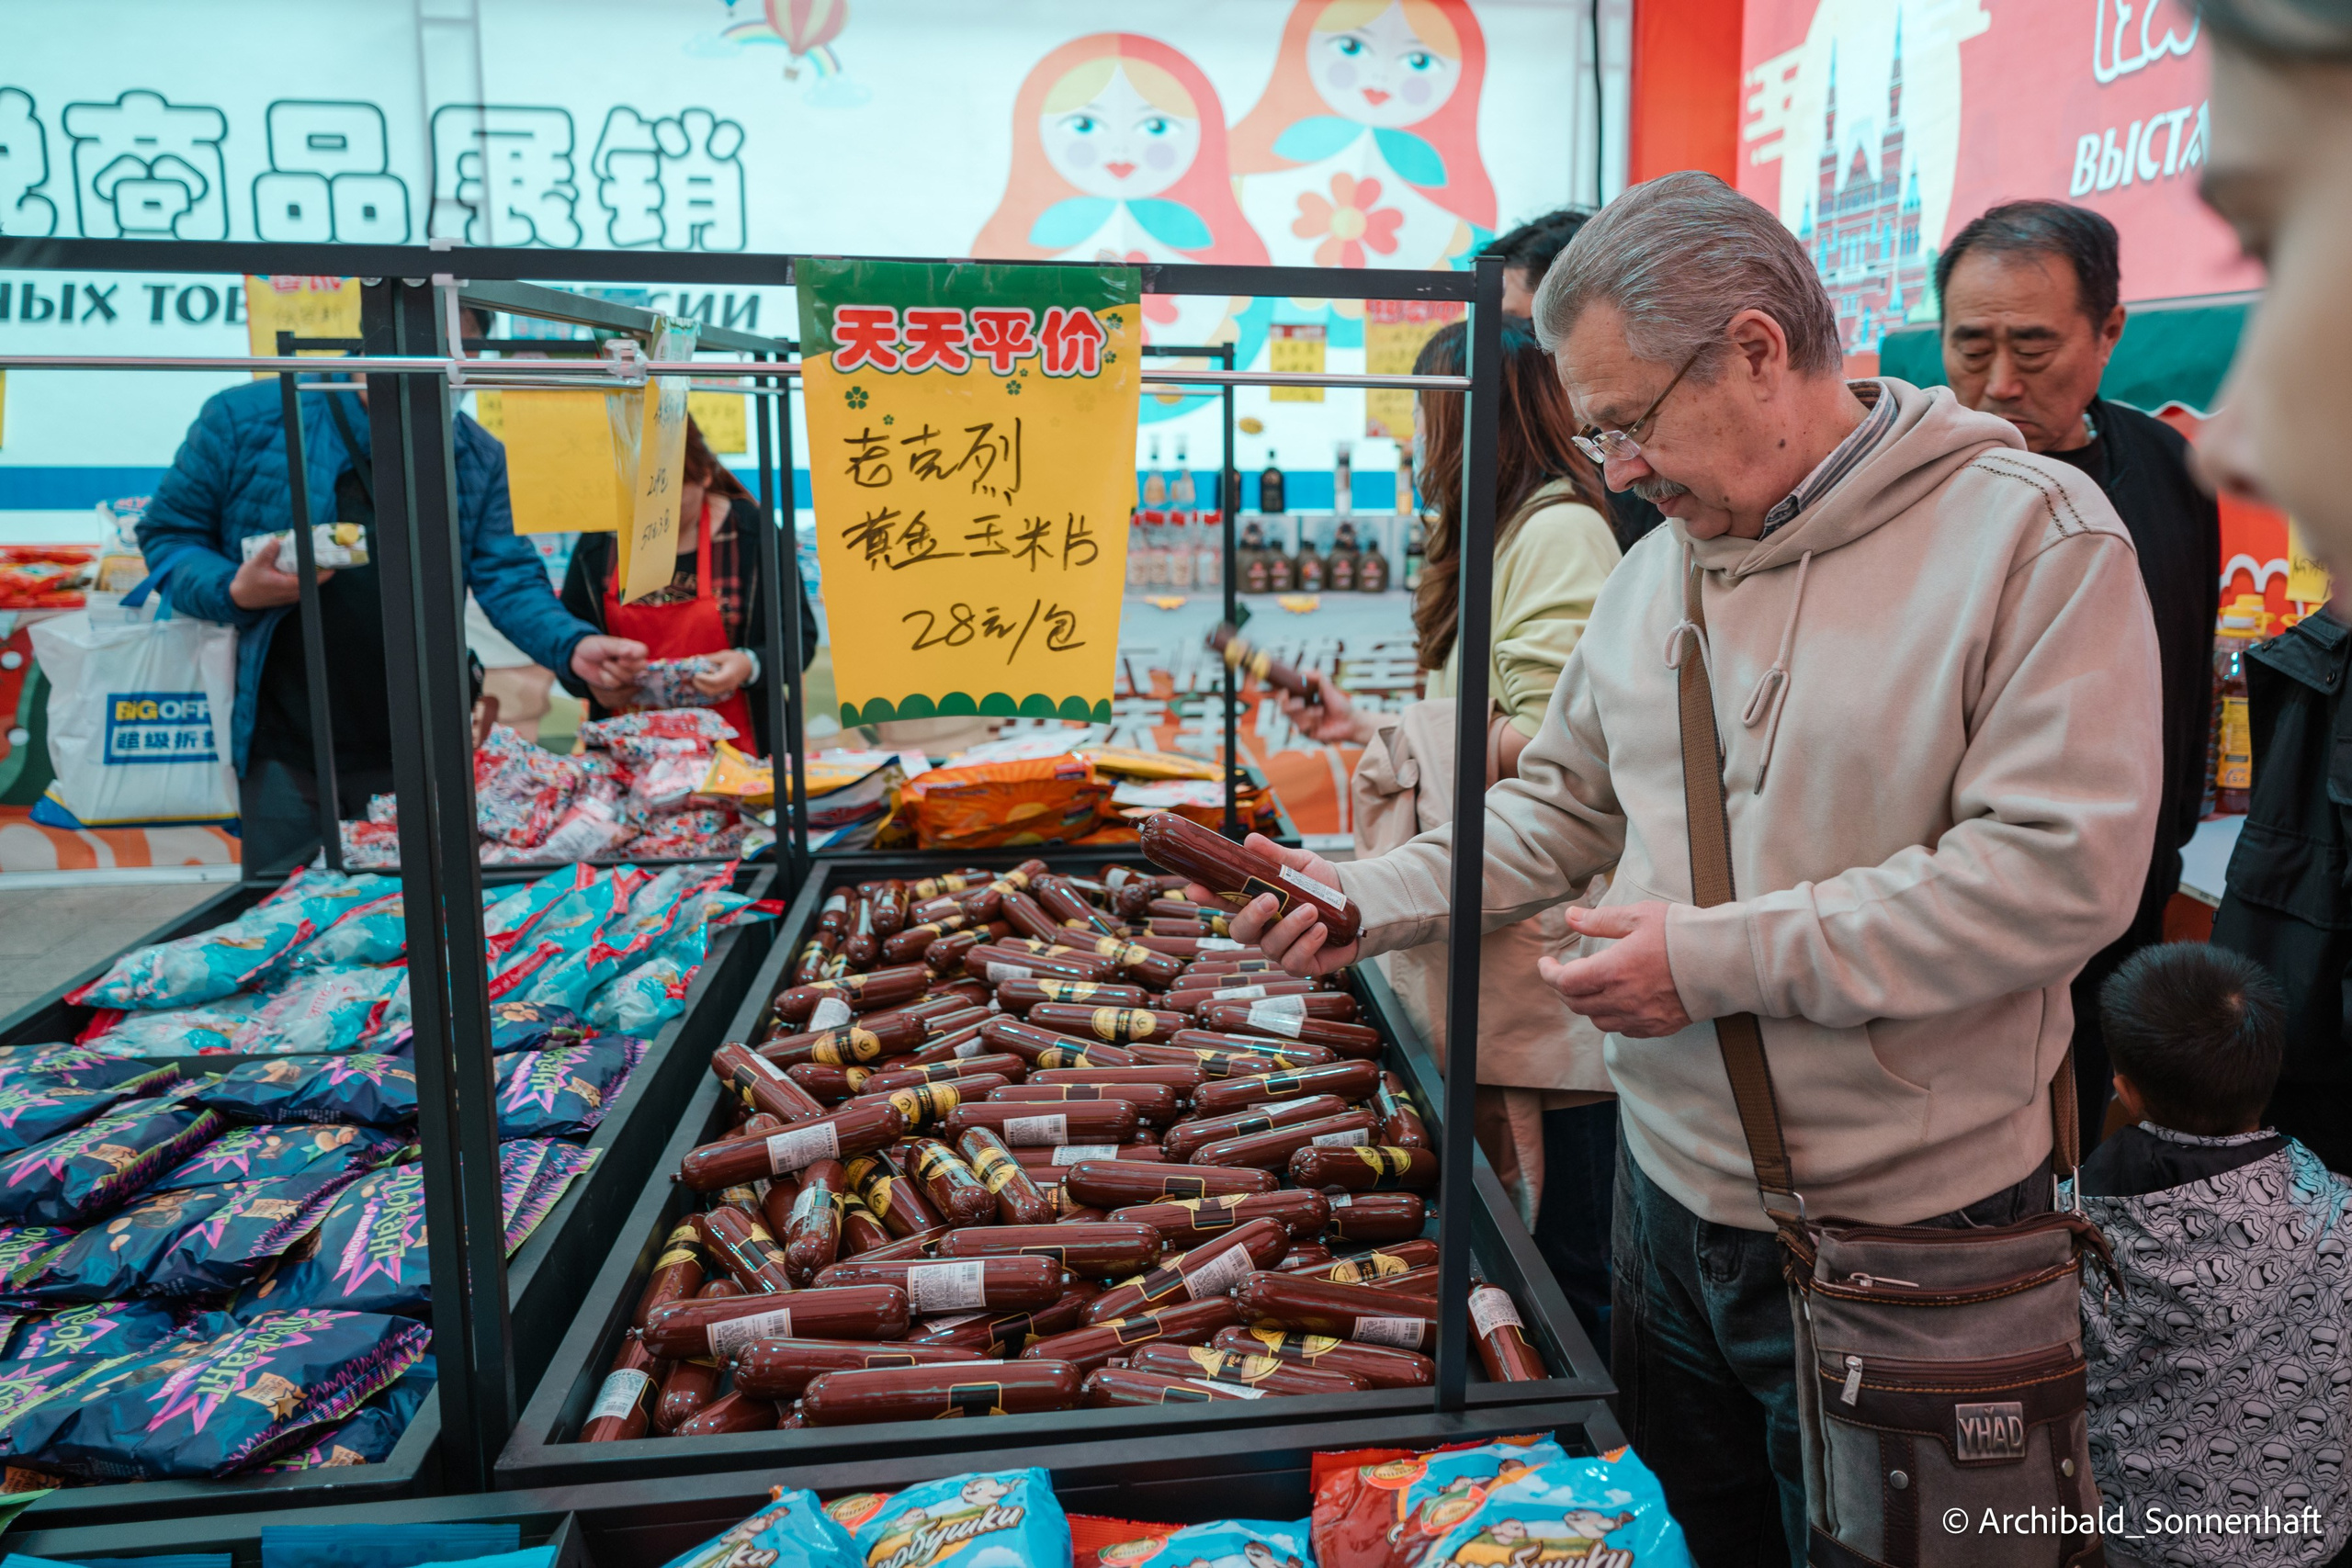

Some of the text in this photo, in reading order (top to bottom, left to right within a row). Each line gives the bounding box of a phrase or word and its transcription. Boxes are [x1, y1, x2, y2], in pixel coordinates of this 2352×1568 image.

[831, 304, 1106, 377] 天天平价
[841, 506, 1099, 573] 黄金玉米片
[901, 598, 1087, 666] 28元/包
[1959, 1416, 2021, 1450] YHAD
